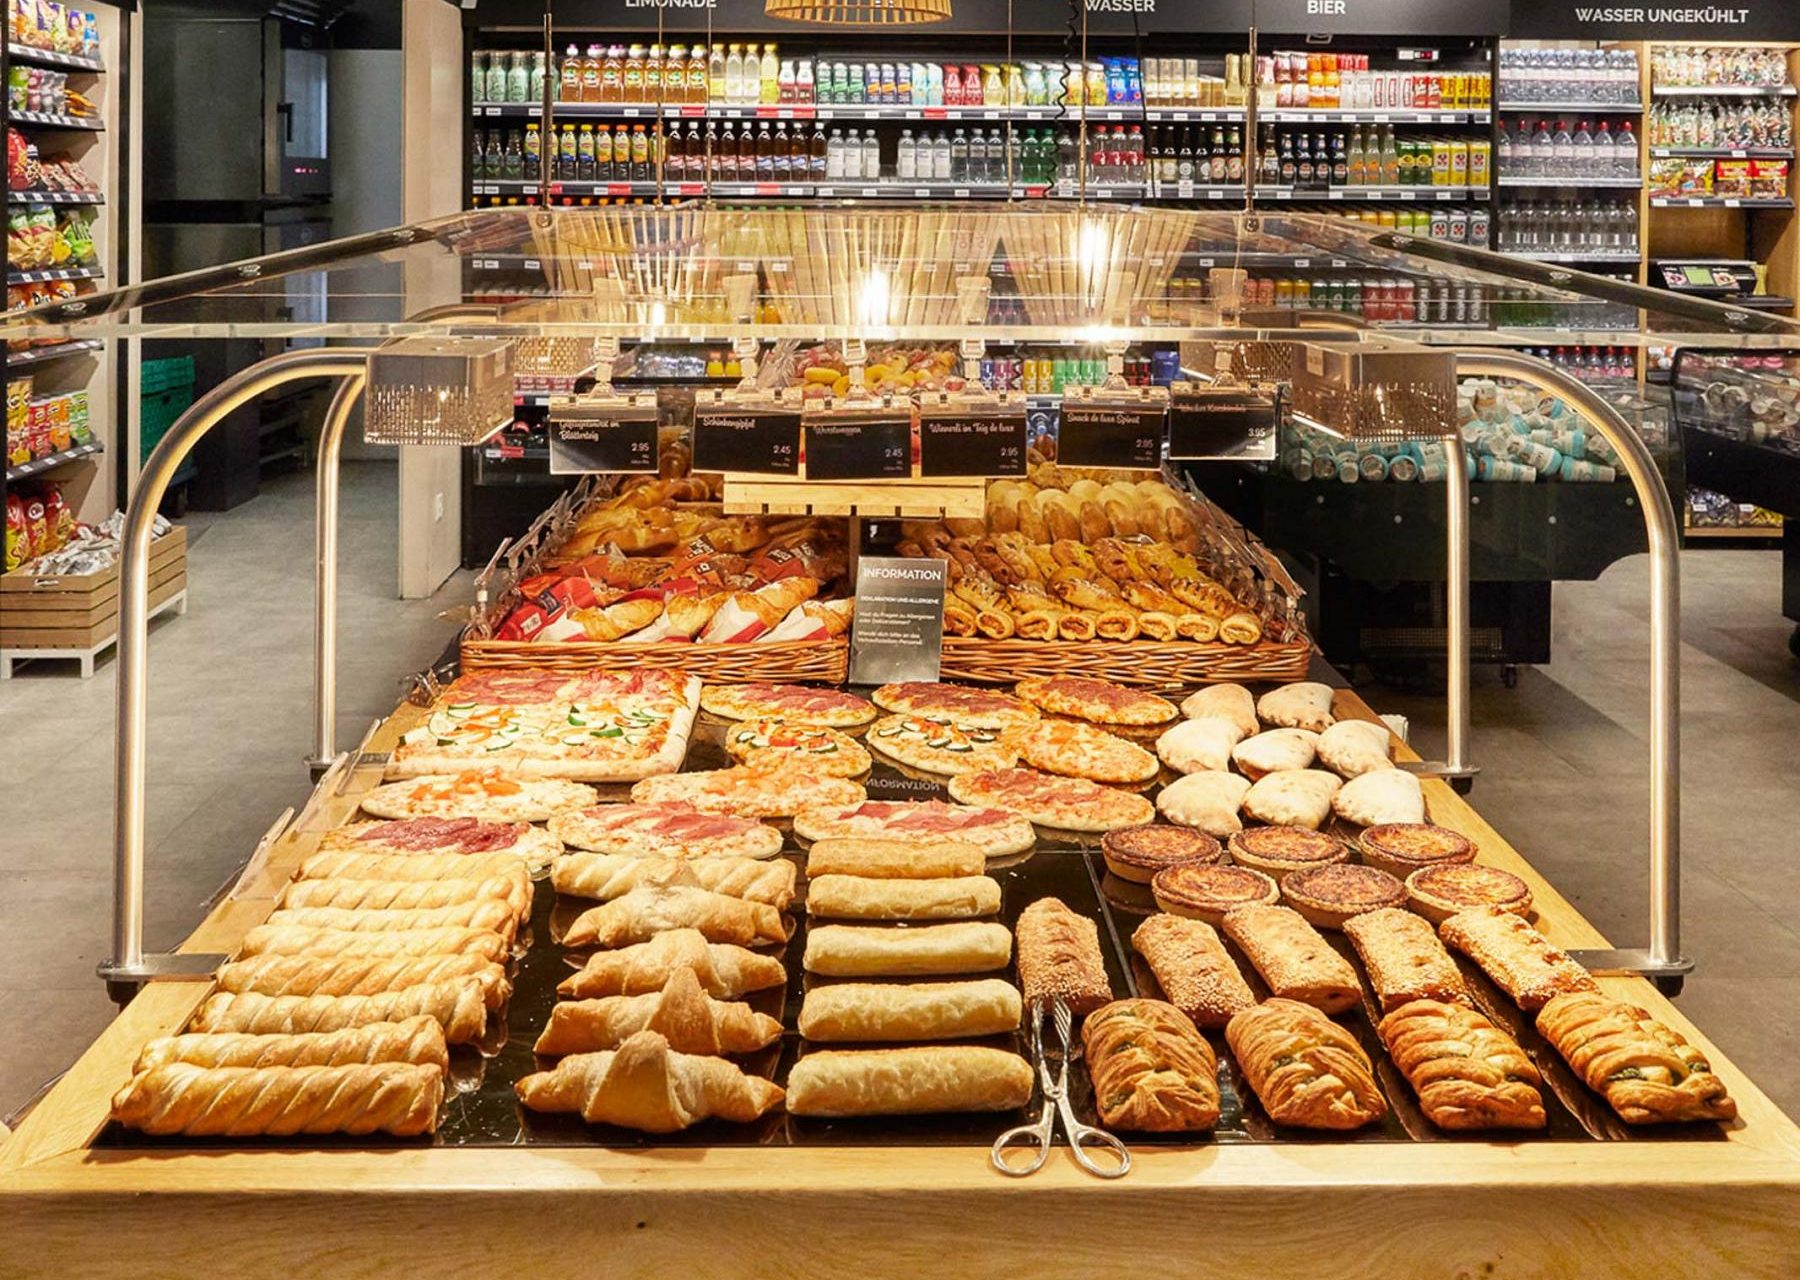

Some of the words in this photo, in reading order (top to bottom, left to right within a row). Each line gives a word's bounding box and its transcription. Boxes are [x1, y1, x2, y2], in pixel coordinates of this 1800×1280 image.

[625, 0, 717, 8] LIMONADE
[1085, 0, 1155, 12] WASSER
[1307, 0, 1346, 14] BIER
[1575, 8, 1644, 22] WASSER
[1648, 6, 1749, 23] UNGEKÜHLT
[973, 422, 989, 435] Teig
[773, 445, 791, 454] 2.45
[884, 448, 903, 458] 2.45
[863, 567, 942, 581] INFORMATION
